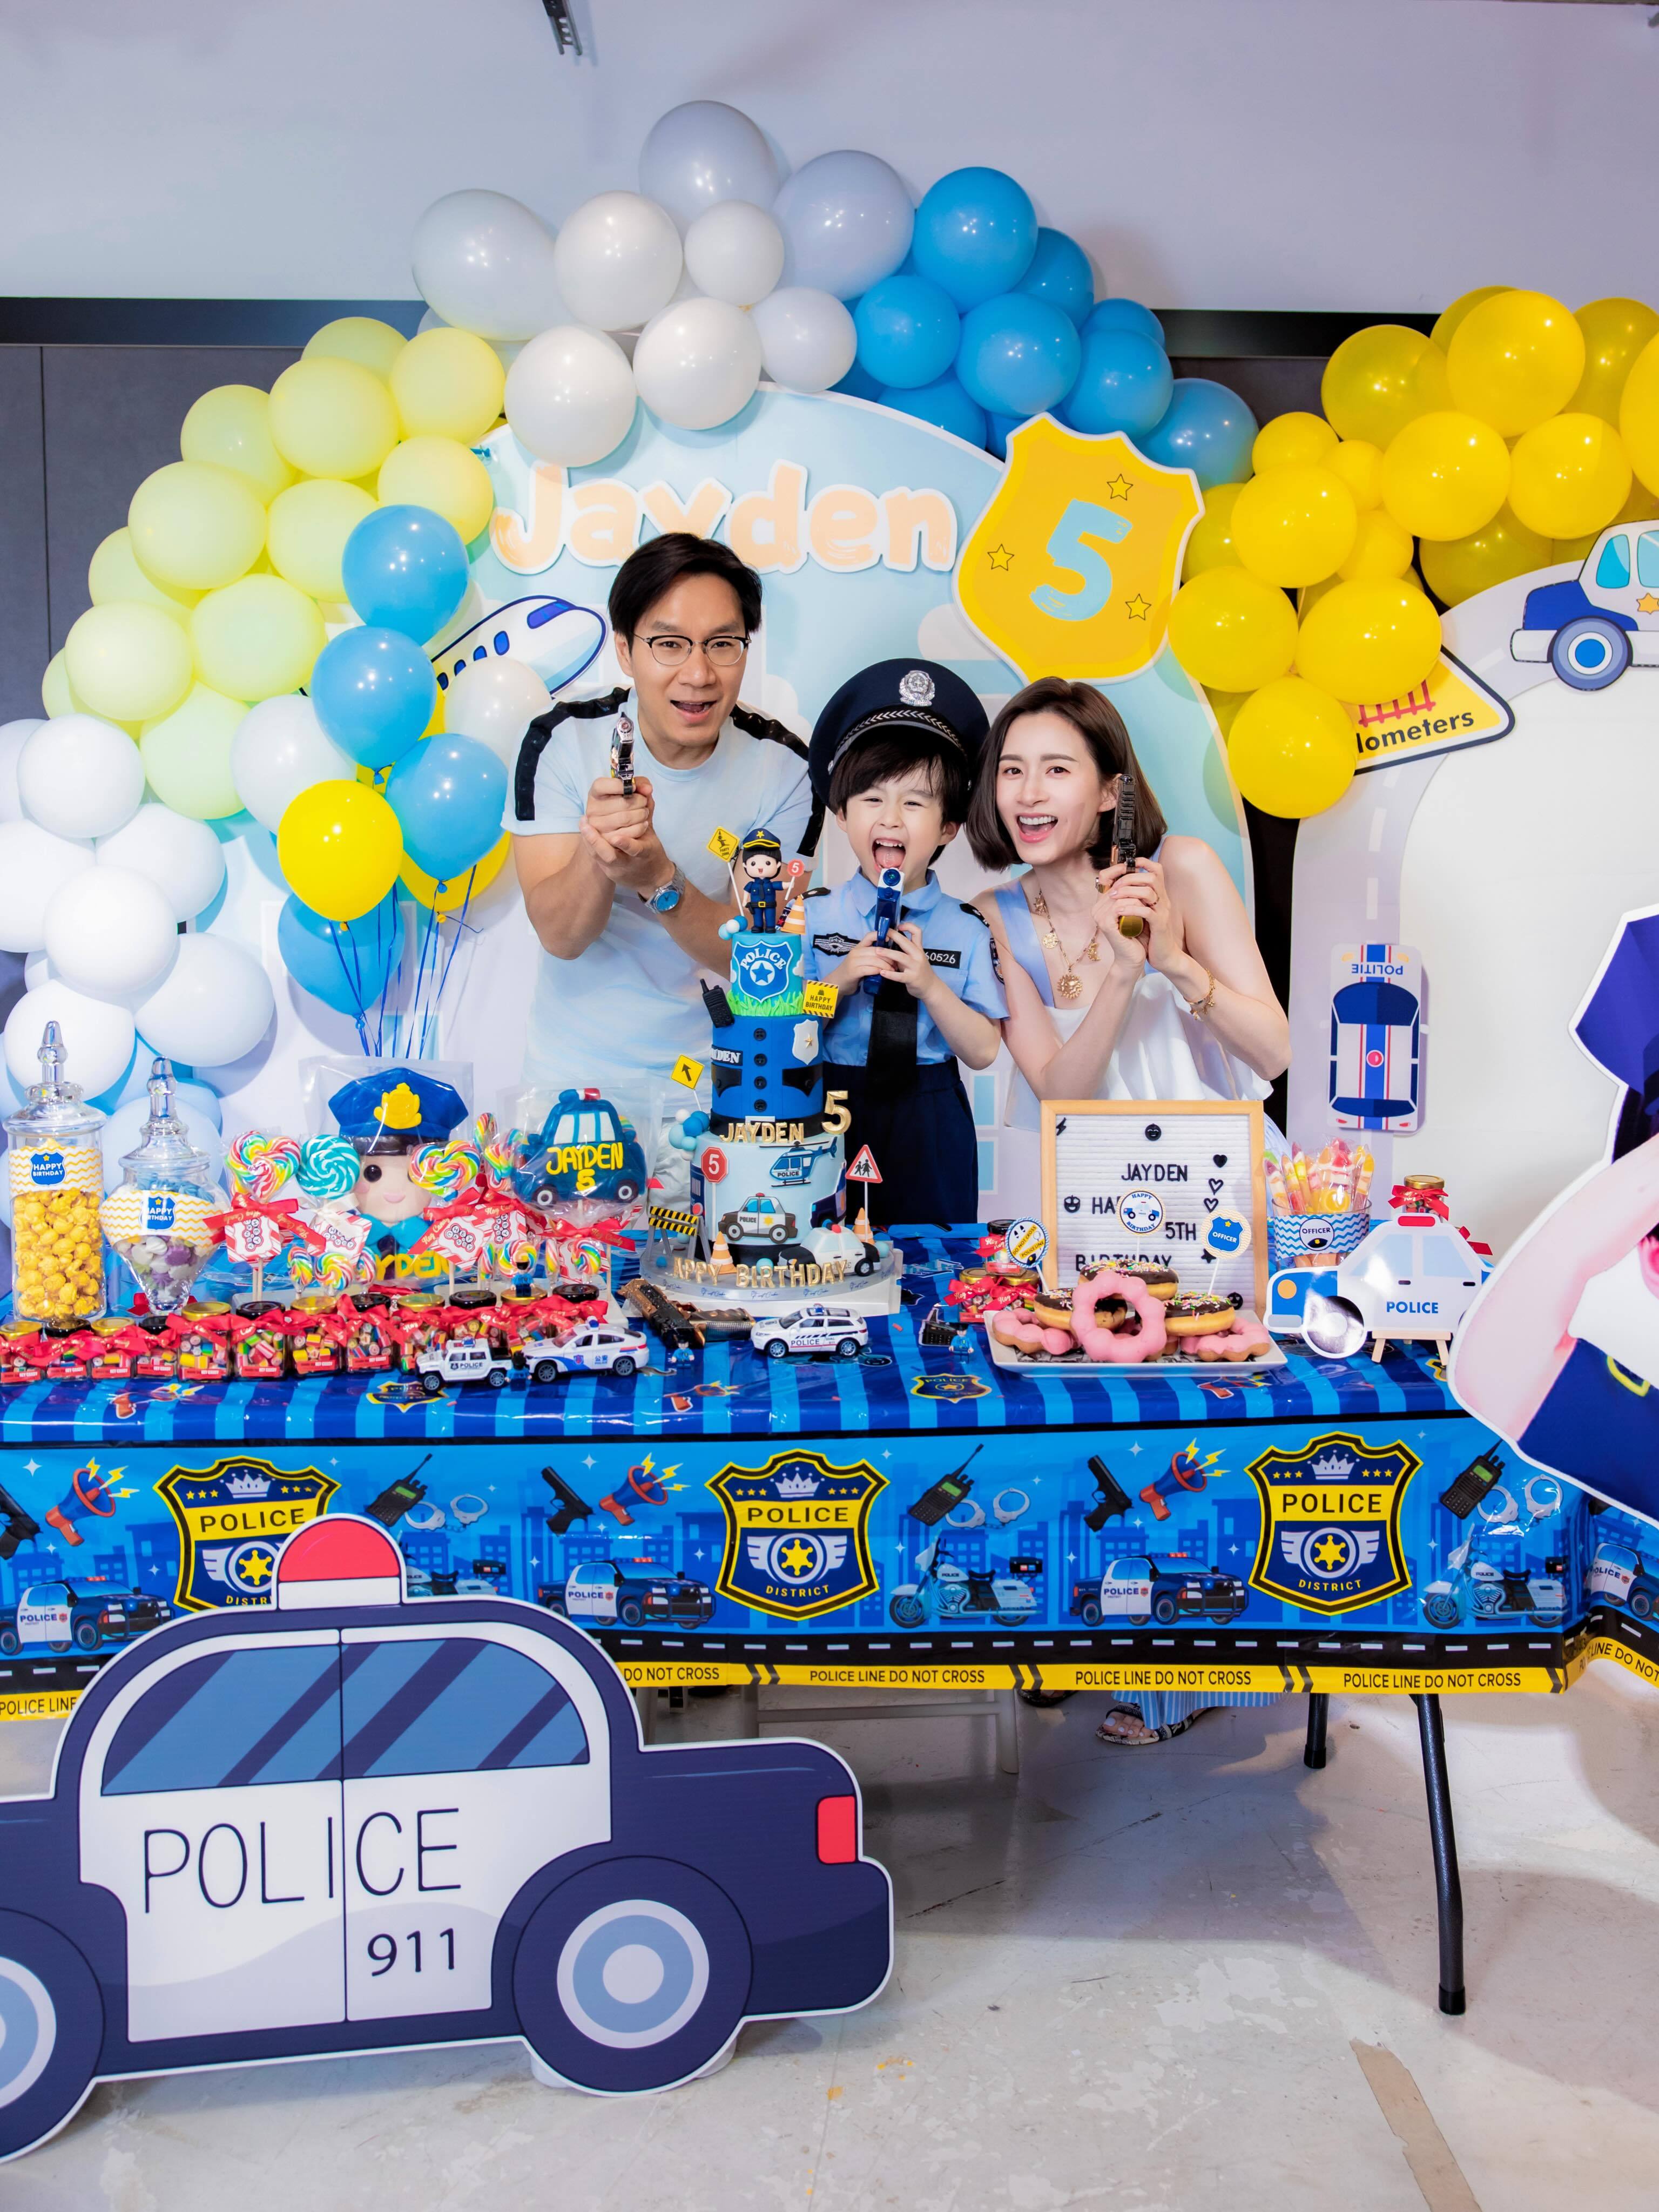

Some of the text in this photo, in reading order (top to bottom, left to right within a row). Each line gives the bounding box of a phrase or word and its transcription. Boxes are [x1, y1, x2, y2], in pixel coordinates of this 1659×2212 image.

[1029, 498, 1133, 622] 5
[791, 862, 800, 873] 5
[740, 948, 787, 970] POLICE
[1351, 963, 1403, 975] POLITIE
[806, 1002, 833, 1011] BIRTHDAY
[810, 995, 831, 1003] HAPPY
[821, 1090, 852, 1135] 5
[719, 1123, 804, 1144] JAYDEN
[546, 1142, 624, 1175] JAYDEN
[709, 1154, 719, 1175] 5
[33, 1163, 62, 1171] HAPPY
[1121, 1163, 1188, 1182] JAYDEN
[576, 1169, 596, 1191] 5
[1127, 1221, 1156, 1232] BIRTHDAY
[1165, 1222, 1196, 1240] 5TH
[1212, 1232, 1237, 1243] OFFICER
[736, 1259, 847, 1288] BIRTHDAY
[1386, 1300, 1439, 1314] POLICE
[1283, 1493, 1382, 1513] POLICE
[200, 1508, 305, 1533] POLICE
[748, 1507, 849, 1522] POLICE
[766, 1584, 829, 1598] DISTRICT
[1298, 1580, 1362, 1591] DISTRICT
[226, 1595, 272, 1606] DISTR
[20, 1614, 57, 1622] POLICE
[1615, 1647, 1633, 1665] DO
[624, 1667, 719, 1681] DO NOT CROSS
[810, 1670, 984, 1683] POLICE LINE DO NOT CROSS
[1076, 1671, 1251, 1685] POLICE LINE DO NOT CROSS
[1344, 1673, 1521, 1688] POLICE LINE DO NOT CROSS
[144, 1808, 461, 1913] POLICE
[367, 1927, 455, 1977] 911
